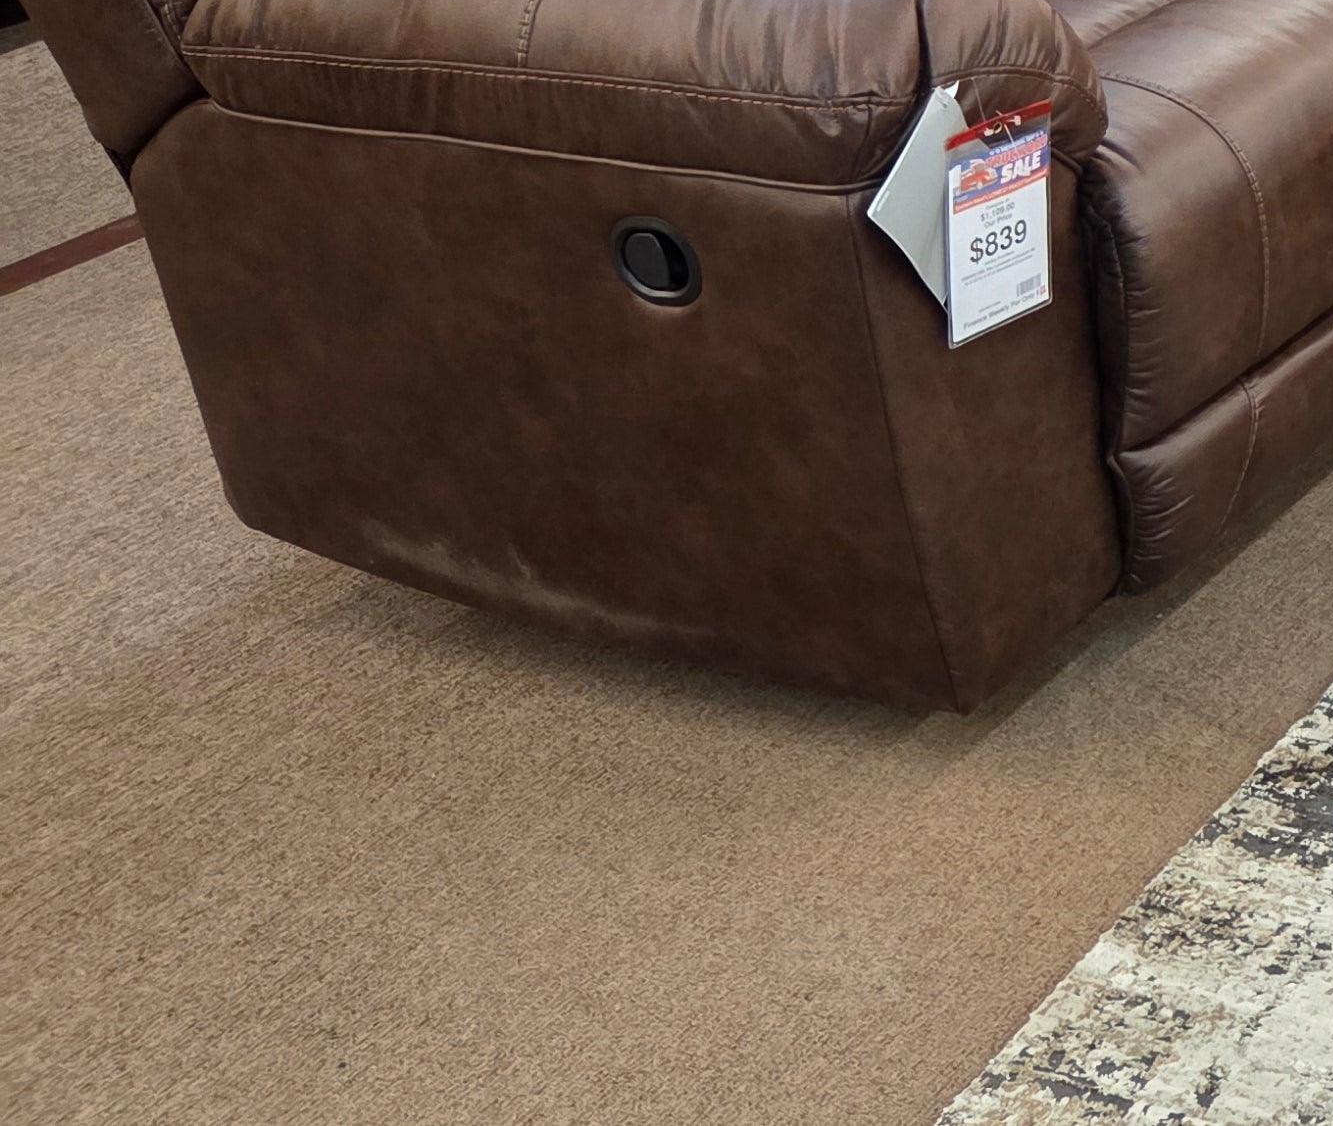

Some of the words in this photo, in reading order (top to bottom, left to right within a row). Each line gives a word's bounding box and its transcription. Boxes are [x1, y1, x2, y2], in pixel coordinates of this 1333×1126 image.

[1000, 150, 1041, 184] SALE
[983, 220, 996, 229] Our
[997, 213, 1012, 223] Price
[970, 219, 1027, 264] $839
[963, 315, 987, 330] Finance
